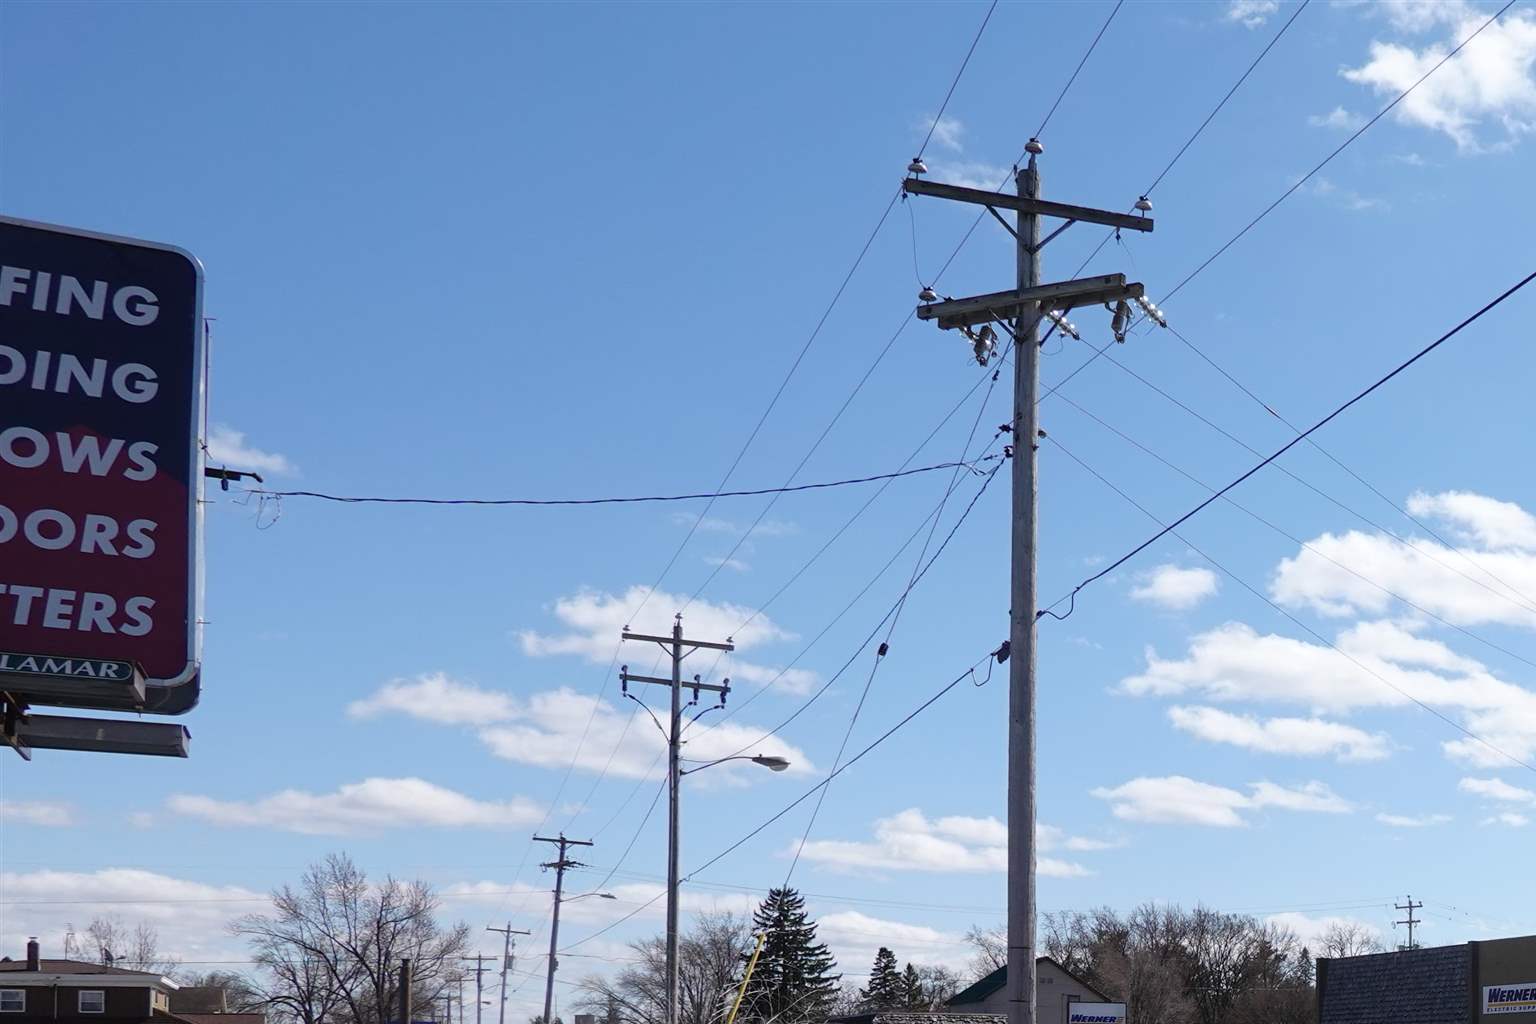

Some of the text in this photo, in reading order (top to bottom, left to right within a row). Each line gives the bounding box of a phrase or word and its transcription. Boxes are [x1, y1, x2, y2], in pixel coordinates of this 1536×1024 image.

[0, 265, 160, 327] FING
[0, 426, 159, 482] OWS
[0, 583, 156, 636] TERS
[0, 654, 119, 678] LAMAR
[1070, 1014, 1117, 1023] WERNER
